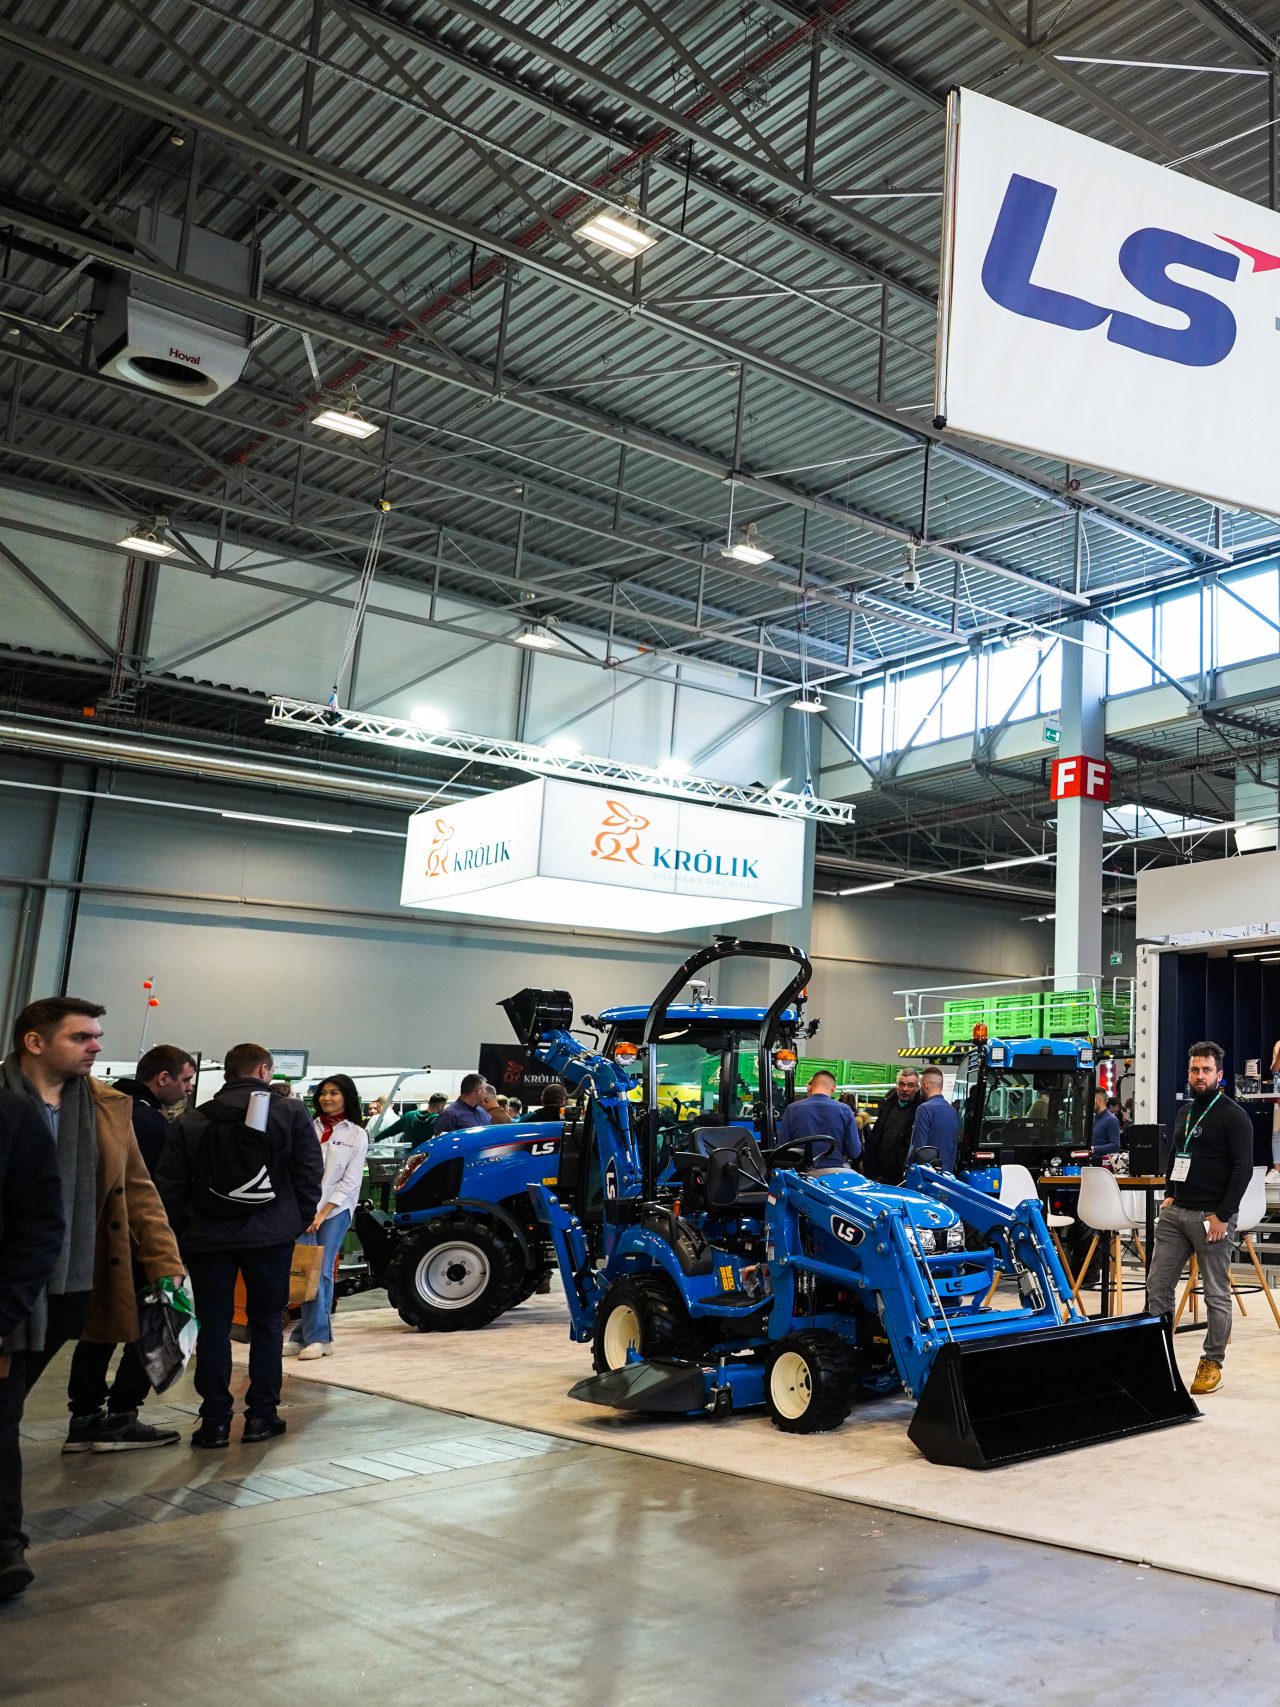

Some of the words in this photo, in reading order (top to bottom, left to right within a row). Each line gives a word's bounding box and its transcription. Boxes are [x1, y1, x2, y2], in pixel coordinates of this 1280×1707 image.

[981, 173, 1241, 367] LS
[169, 347, 201, 365] Hoval
[1057, 760, 1077, 796] F
[1086, 762, 1106, 795] F
[453, 840, 512, 873] KRÓLIK
[652, 846, 759, 879] KRÓLIK
[524, 1074, 562, 1083] KRÓLIK
[531, 1142, 555, 1156] LS
[606, 1172, 616, 1200] LS
[837, 1222, 856, 1242] LS
[946, 1280, 964, 1293] LS
